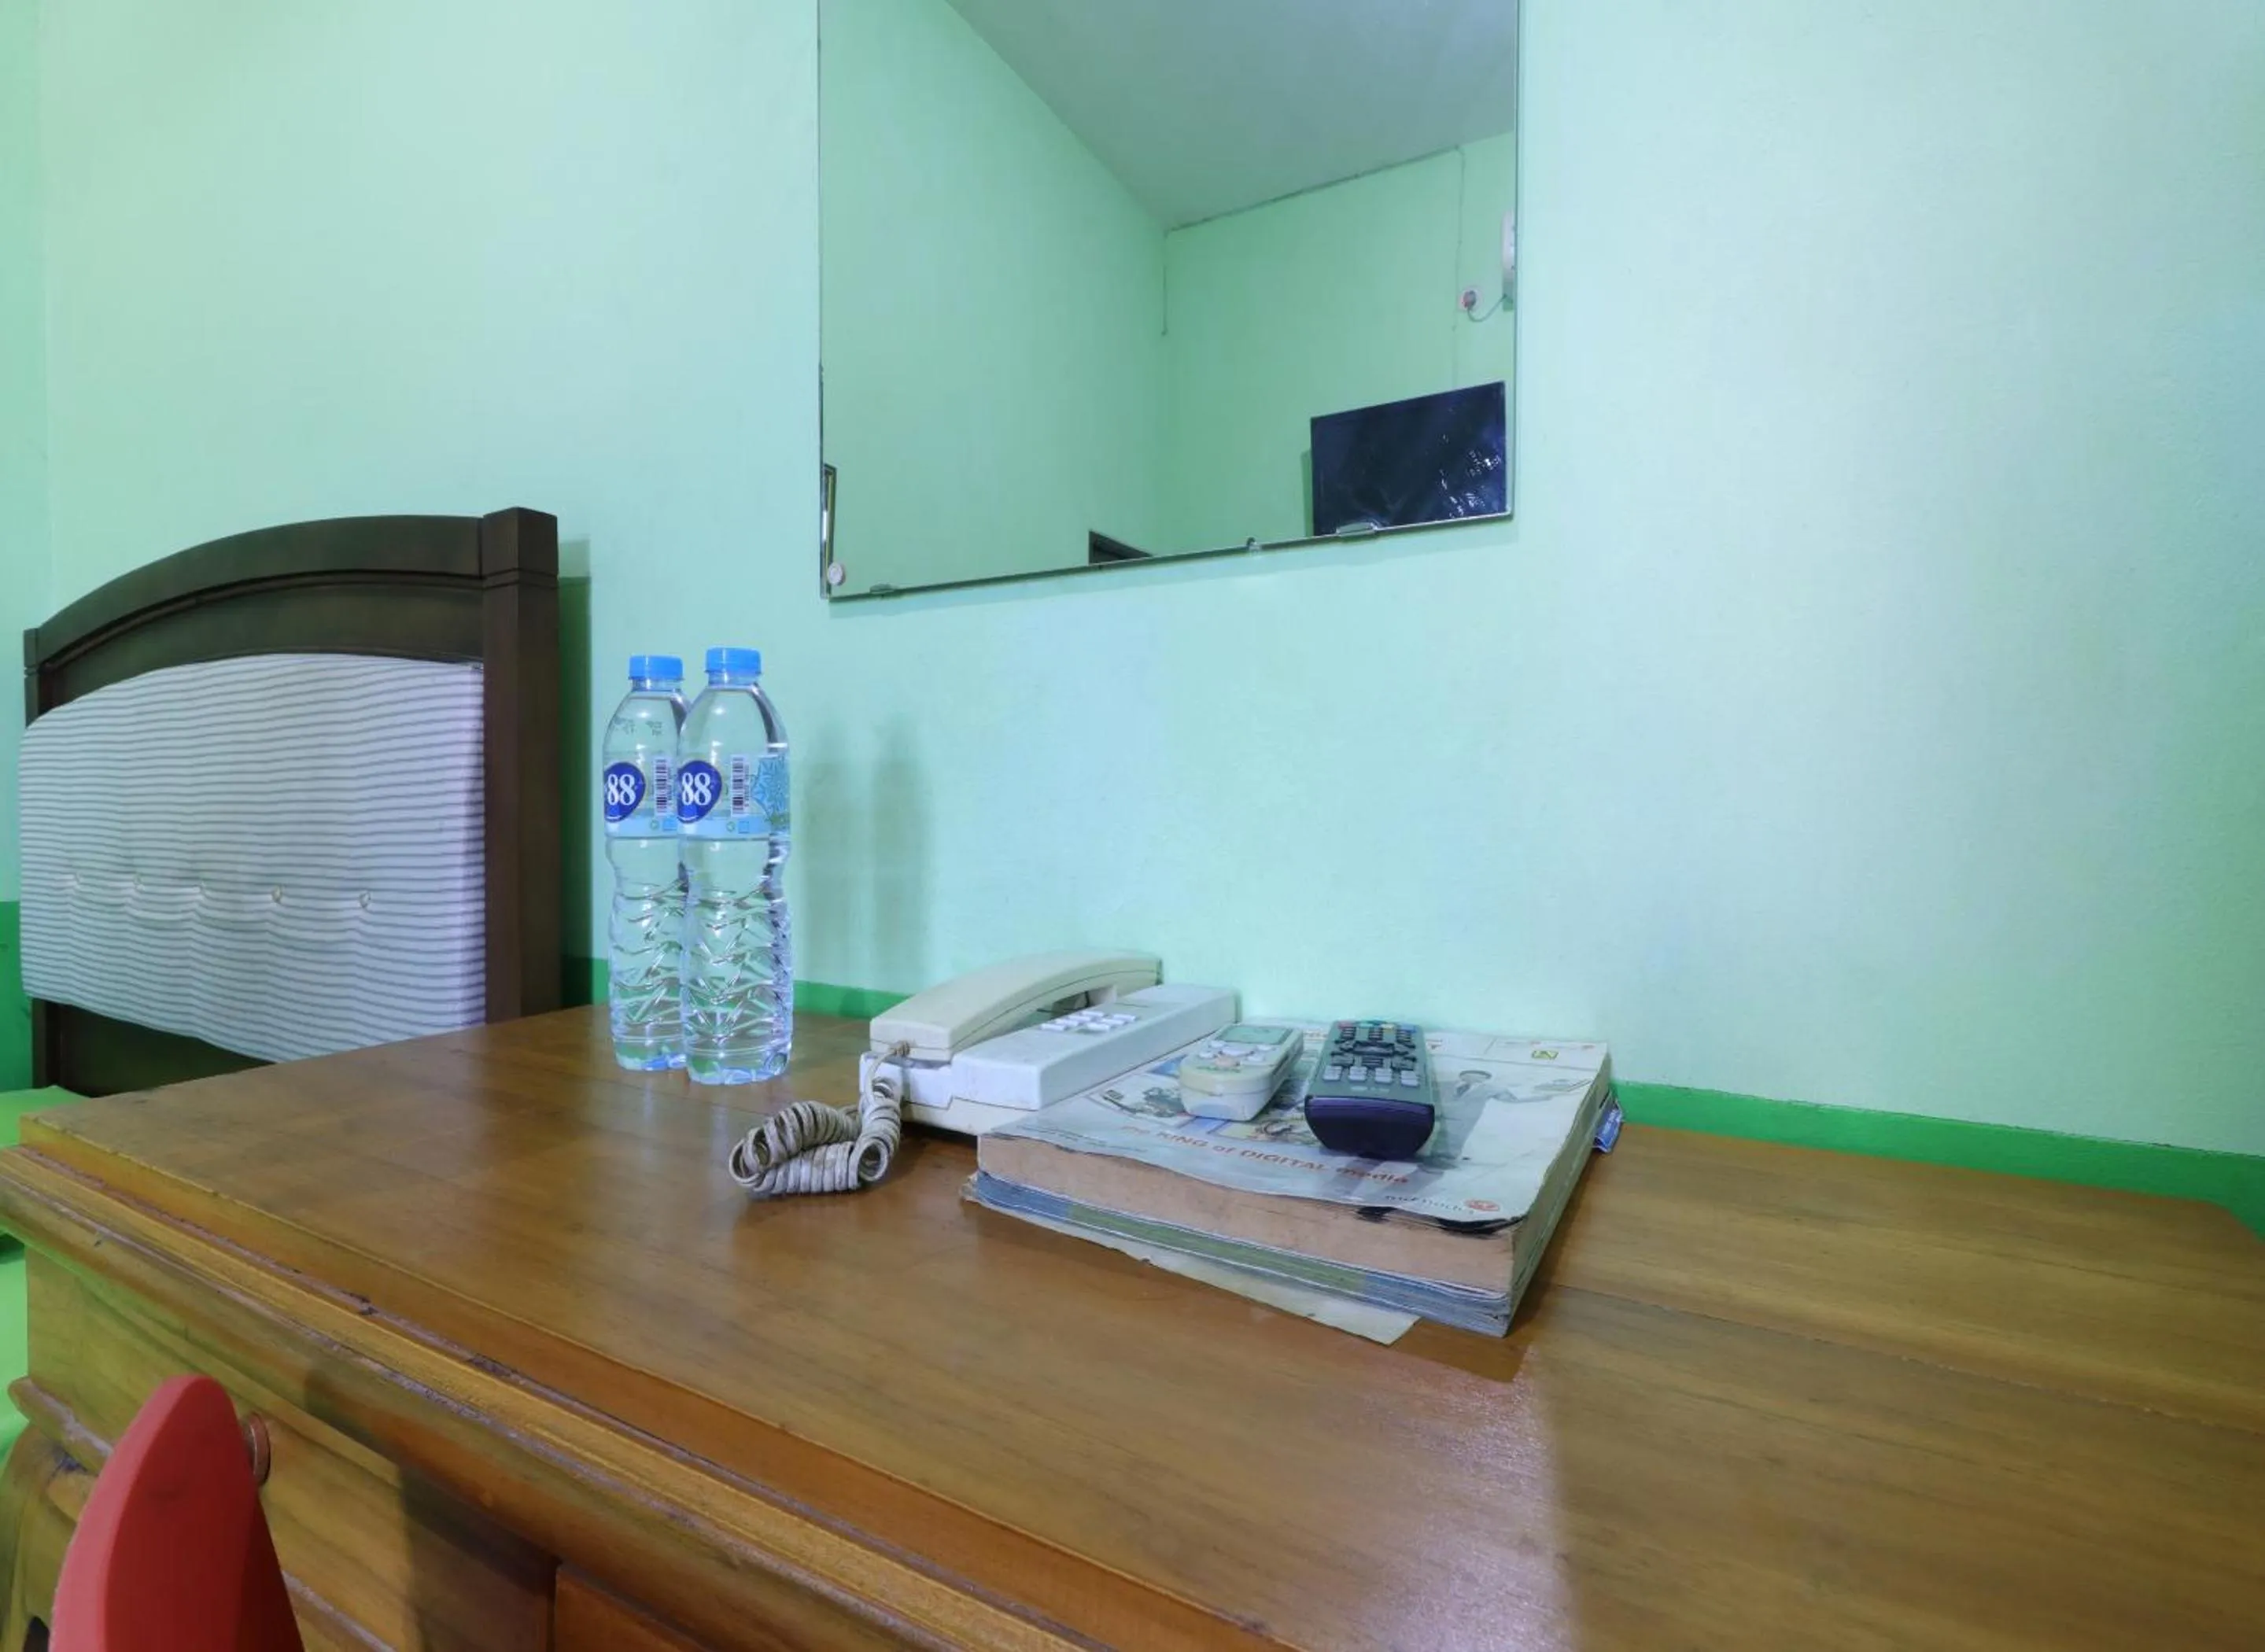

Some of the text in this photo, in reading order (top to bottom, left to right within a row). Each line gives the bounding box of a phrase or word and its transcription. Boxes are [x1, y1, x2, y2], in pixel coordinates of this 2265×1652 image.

[607, 773, 636, 805] 88
[681, 773, 711, 805] 88
[1156, 1130, 1209, 1148] KING
[1240, 1149, 1327, 1171] DIGITAL
